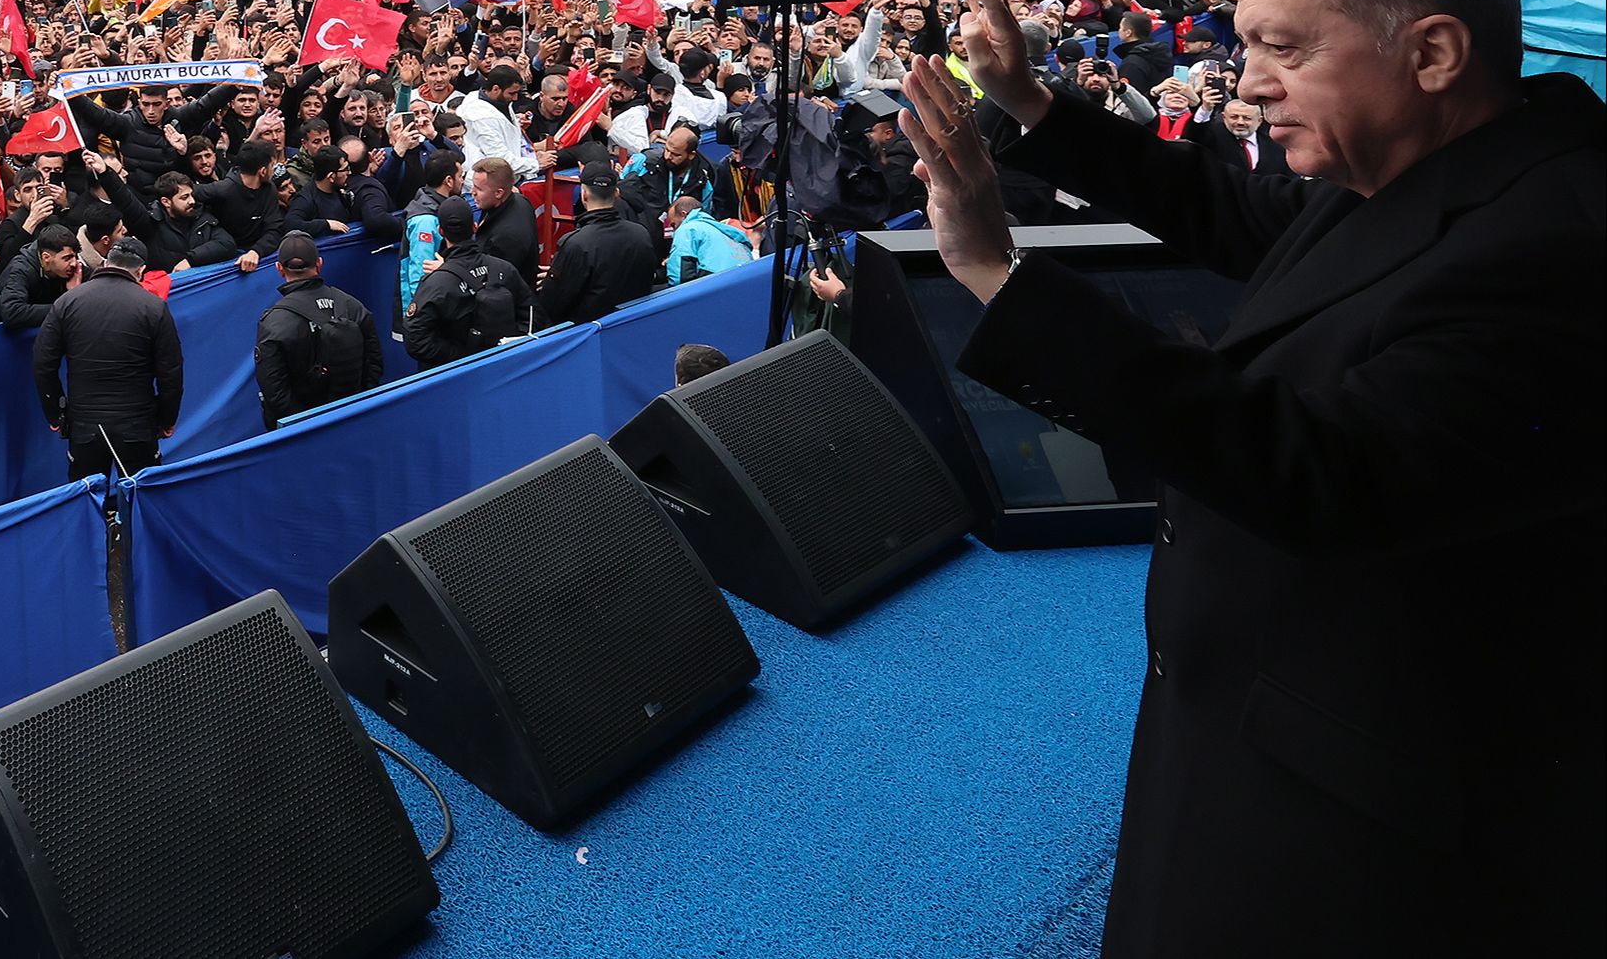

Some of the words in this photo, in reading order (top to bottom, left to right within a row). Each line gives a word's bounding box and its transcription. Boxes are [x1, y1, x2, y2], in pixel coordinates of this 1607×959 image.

[87, 71, 111, 85] ALİ
[116, 67, 173, 83] MURAT
[178, 65, 232, 78] BUCAK
